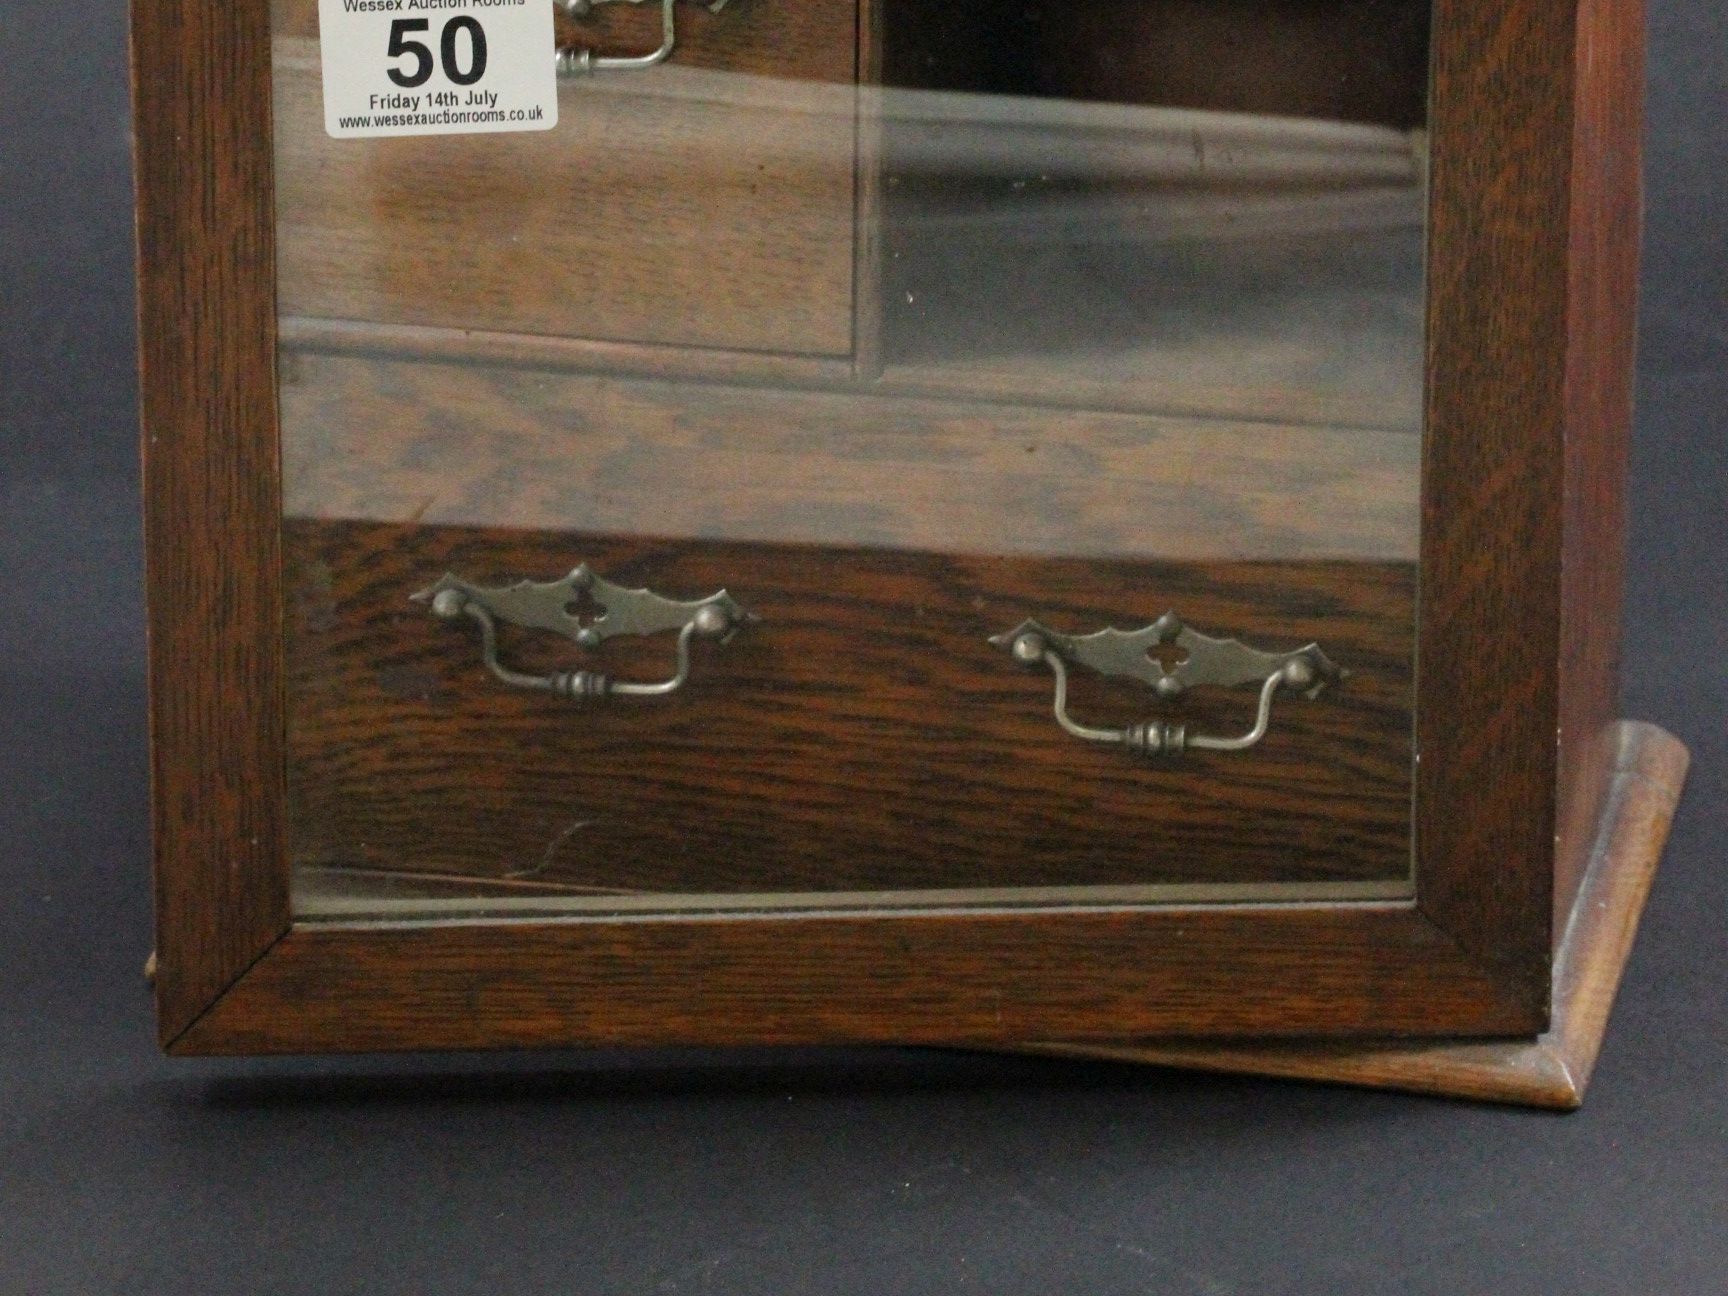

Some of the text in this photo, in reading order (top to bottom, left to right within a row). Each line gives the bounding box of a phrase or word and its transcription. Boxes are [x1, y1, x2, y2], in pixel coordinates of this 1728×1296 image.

[386, 15, 488, 88] 50
[369, 90, 498, 111] Friday 14th July
[339, 105, 543, 128] www.wessexauctionrooms.co.uk
